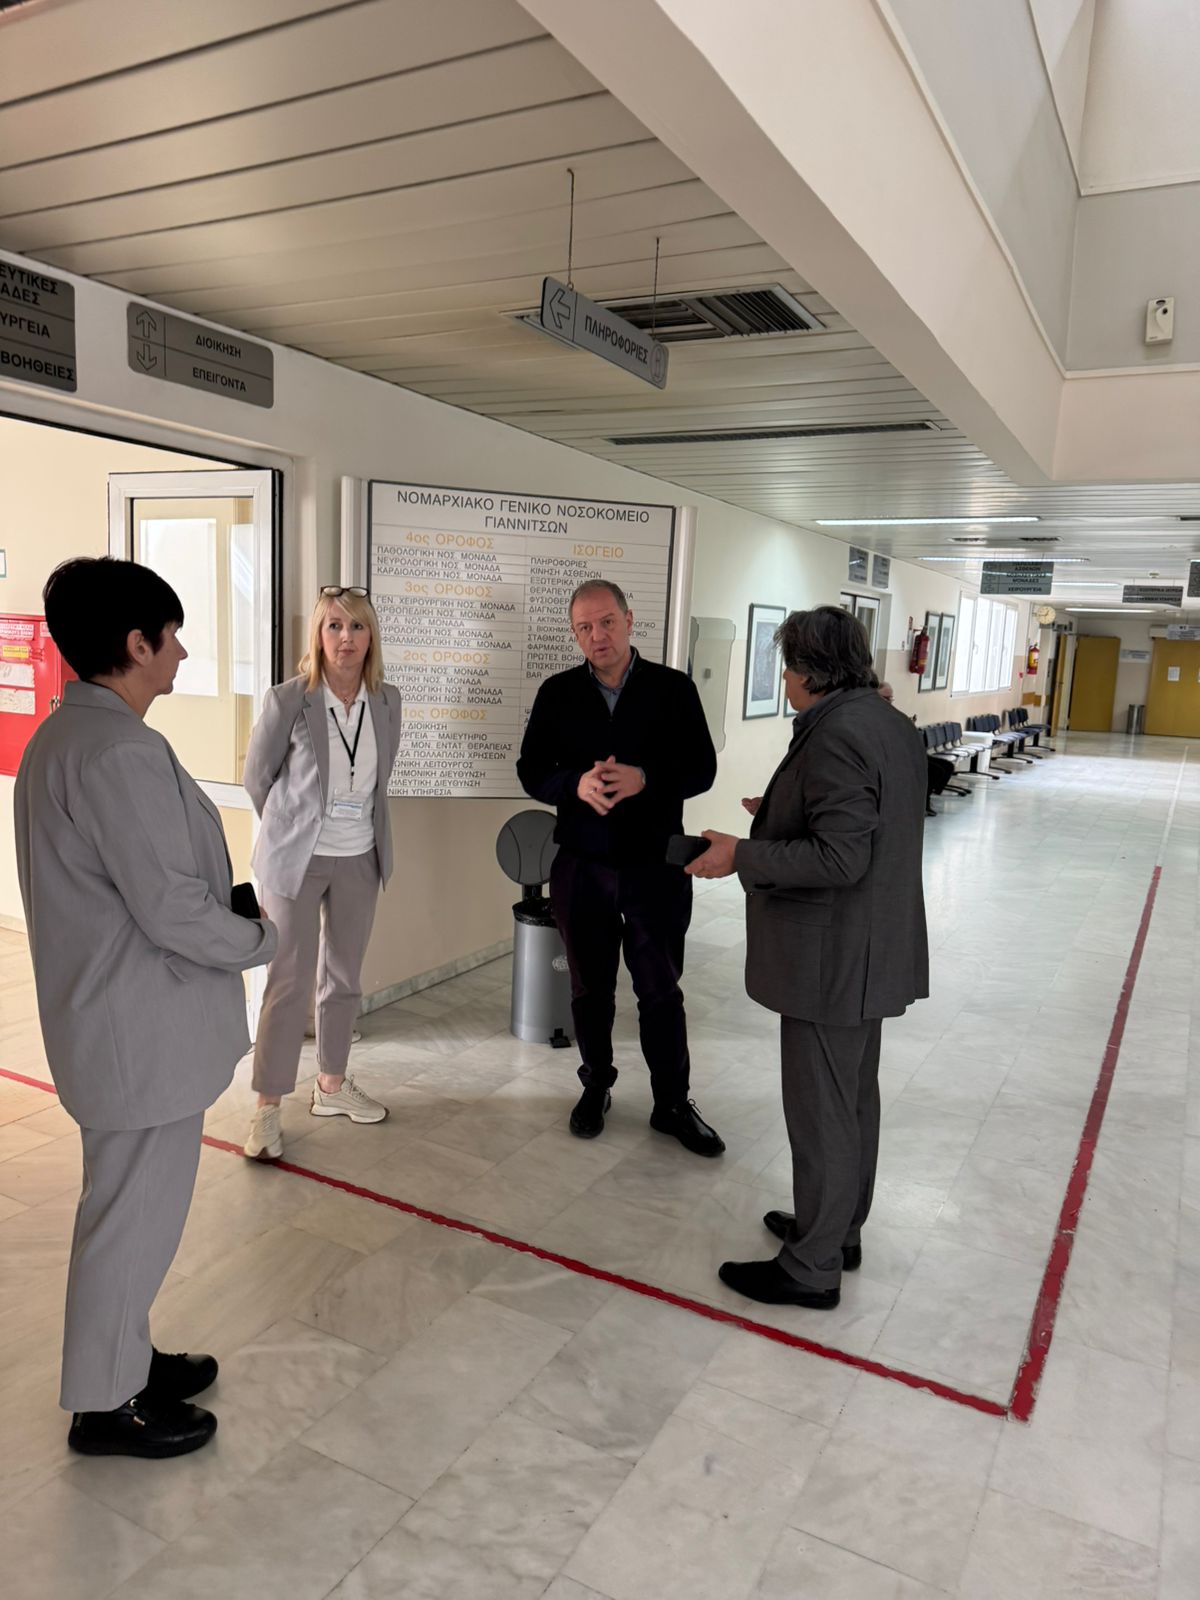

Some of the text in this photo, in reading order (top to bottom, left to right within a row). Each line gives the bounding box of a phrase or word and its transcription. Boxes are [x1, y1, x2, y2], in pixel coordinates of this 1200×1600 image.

[584, 315, 648, 364] ΠΛΗΡΟΦΟΡΙΕΣ
[196, 334, 241, 358] ΔΙΟΙΚΗΣΗ
[0, 352, 74, 381] ΒΟΗΘΕΙΕΣ
[192, 366, 246, 392] ΕΠΕΙΓΟΝΤΑ
[398, 490, 650, 523] ΝΟΜΑΡΧΙΑΚΟ ΓΕΝΙΚΟ ΝΟΣΟΚΟΜΕΙΟ
[485, 516, 568, 534] ΓΙΑΝΝΙΤΣΩΝ
[406, 532, 494, 550] 4ος ΟΡΟΦΟΣ
[377, 546, 434, 558] ΠΑΘΟΛΟΓΙΚΗ
[461, 552, 497, 562] ΜΟΝΑΔΑ
[573, 544, 624, 558] ΙΣΟΓΕΙΟ
[377, 556, 438, 568] ΝΕΥΡΟΛΟΓΙΚΗ
[464, 562, 500, 572] ΜΟΝΑΔΑ
[530, 558, 588, 568] ΠΛΗΡΟΦΟΡΙΕΣ
[377, 567, 440, 578] ΚΑΡΔΙΟΛΟΓΙΚΗ
[466, 572, 502, 582] ΜΟΝΑΔΑ
[530, 568, 602, 578] ΚΙΝΗΣΗ ΑΣΘΕΝΩΝ
[530, 578, 574, 586] ΕΞΩΤΕΡΙΚΑ
[405, 581, 493, 598] 3ος ΟΡΟΦΟΣ
[399, 598, 454, 608] ΧΕΙΡΟΥΡΓΙΚΗ
[480, 602, 516, 611] ΜΟΝΑΔΑ
[376, 606, 434, 616] ΟΡΘΟΠΕΔΙΚΗ
[460, 610, 496, 620] ΜΟΝΑΔΑ
[428, 618, 465, 627] ΜΟΝΑΔΑ
[458, 630, 493, 639] ΜΟΝΑΔΑ
[528, 634, 566, 642] ΣΤΑΘΜΟΣ
[476, 640, 512, 649] ΜΟΝΑΔΑ
[527, 644, 574, 652] ΦΑΡΜΑΚΕΙΟ
[403, 650, 491, 664] 2ος ΟΡΟΦΟΣ
[526, 653, 558, 662] ΠΡΩΤΕΣ
[454, 668, 489, 676] ΜΟΝΑΔΑ
[446, 677, 482, 685] ΜΟΝΑΔΑ
[468, 688, 503, 696] ΜΟΝΑΔΑ
[467, 696, 502, 705] ΜΟΝΑΔΑ
[404, 708, 488, 720] 1ος ΟΡΟΦΟΣ
[408, 722, 448, 730] ΔΙΟΙΚΗΣΗ
[438, 733, 488, 741] ΜΑΙΕΥΤΗΡΙΟ
[414, 751, 465, 759] ΠΟΛΛΑΠΛΩΝ
[468, 752, 506, 760] ΧΡΗΣΕΩΝ
[440, 770, 486, 778] ΔΙΕΥΘΥΝΣΗ
[412, 788, 452, 796] ΥΠΗΡΕΣΙΑ
